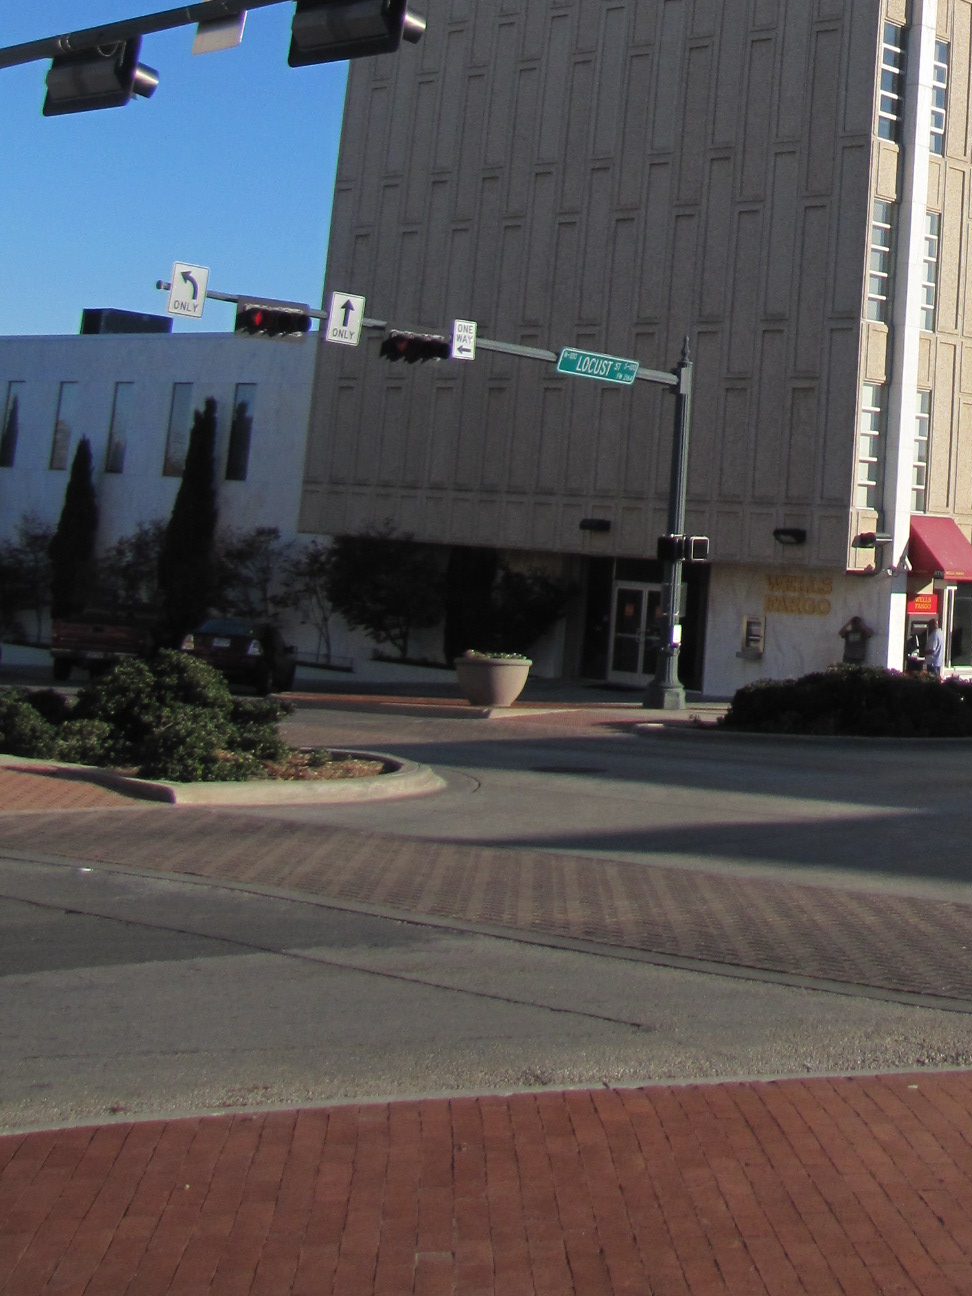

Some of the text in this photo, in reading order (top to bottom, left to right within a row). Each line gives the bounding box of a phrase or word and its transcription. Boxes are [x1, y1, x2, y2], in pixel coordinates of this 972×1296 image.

[173, 299, 199, 313] ONLY
[332, 327, 355, 340] ONLY
[457, 324, 474, 334] ONE
[456, 334, 474, 344] WAY
[576, 356, 622, 376] LOCUST ST
[763, 574, 833, 595] WELLS
[763, 594, 831, 617] FARGO
